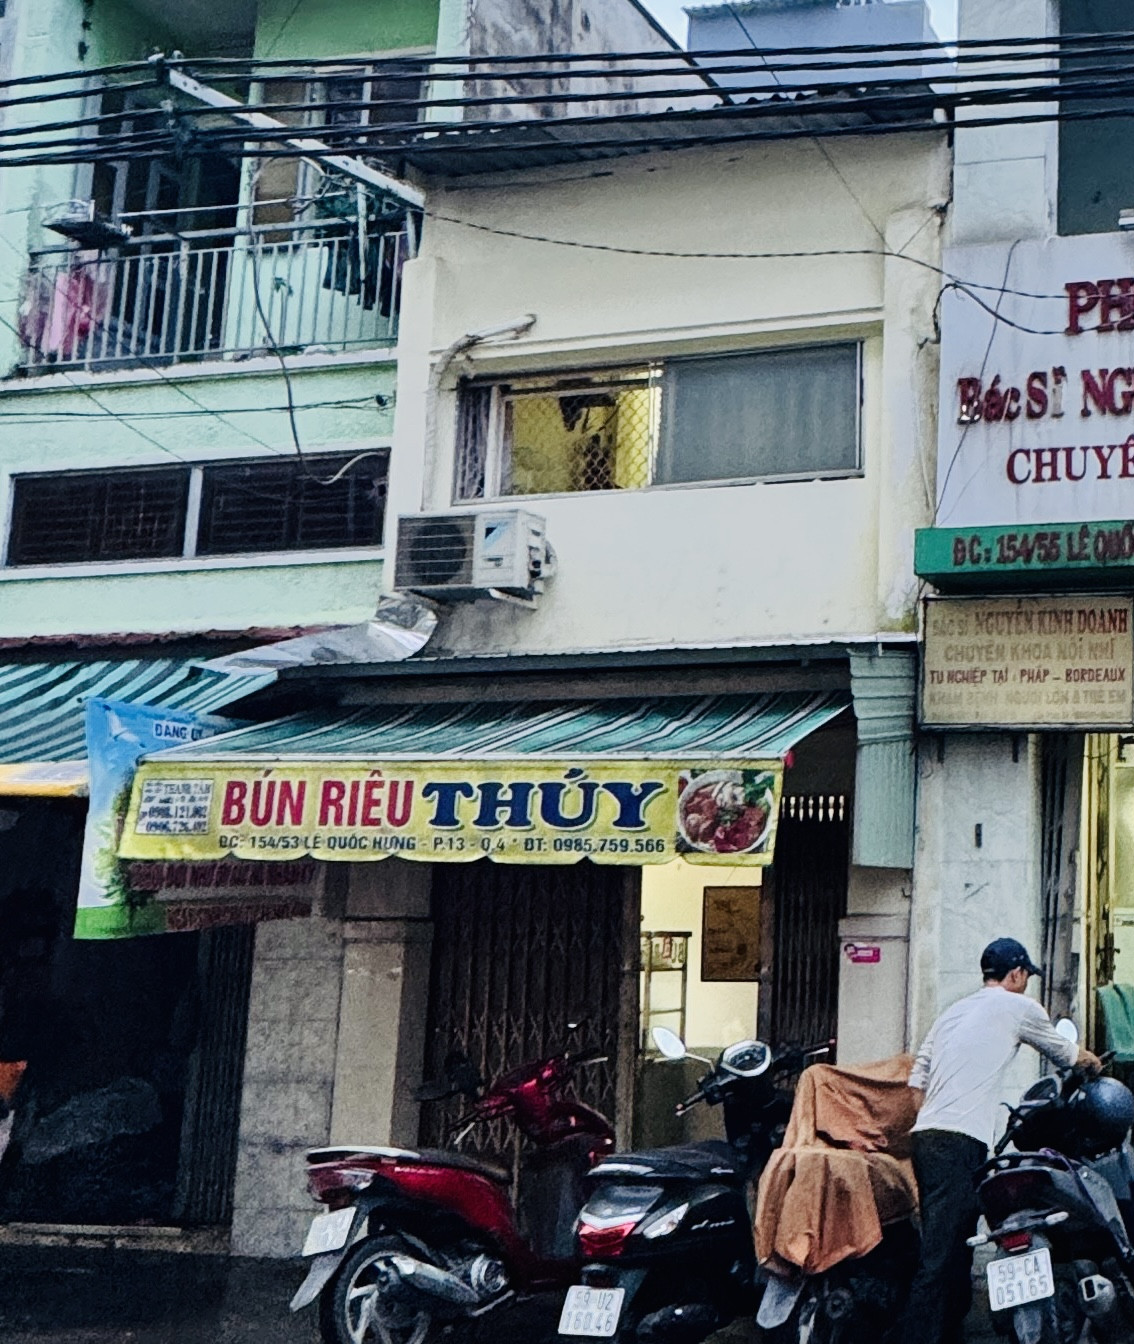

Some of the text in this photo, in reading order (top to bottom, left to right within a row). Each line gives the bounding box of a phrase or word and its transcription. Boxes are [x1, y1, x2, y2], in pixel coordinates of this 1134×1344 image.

[1077, 607, 1128, 634] DOANH
[1065, 667, 1126, 684] BORDEAUX
[221, 767, 665, 831] BÚN RIÊU THÚY
[251, 835, 299, 850] 154/53
[433, 837, 465, 852] P.13
[553, 838, 665, 853] 0985.759.566
